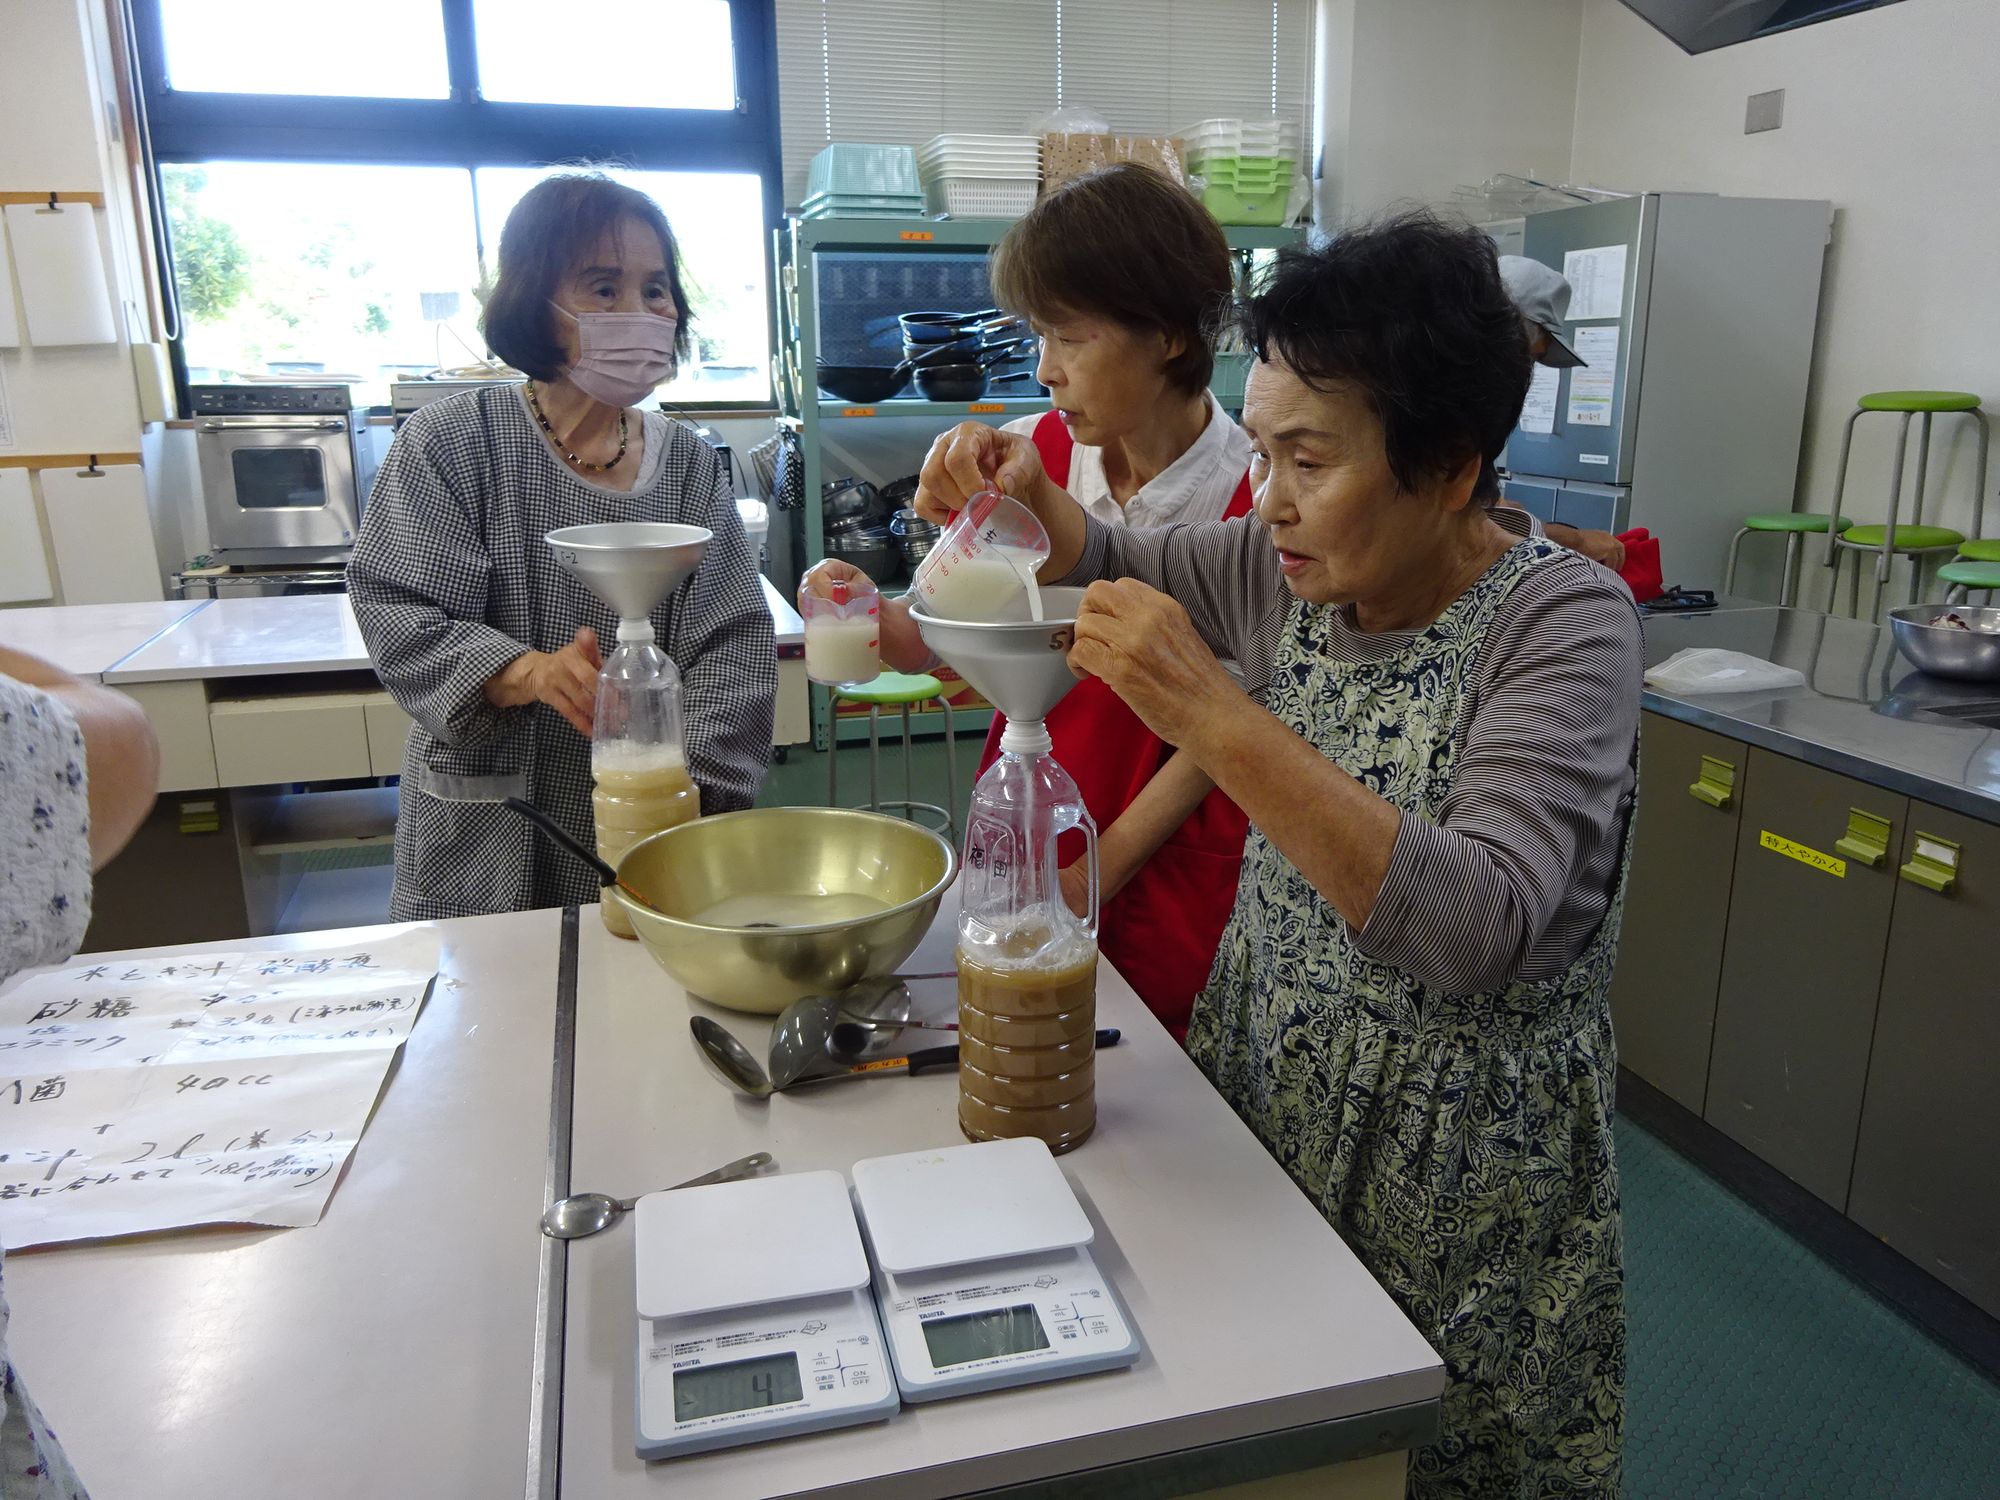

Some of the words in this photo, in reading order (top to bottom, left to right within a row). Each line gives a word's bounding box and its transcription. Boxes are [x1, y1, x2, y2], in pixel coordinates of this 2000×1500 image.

[951, 552, 960, 565] 70
[941, 566, 950, 577] 50
[926, 583, 936, 595] 20
[1764, 834, 1843, 874] 特大やかん
[257, 953, 381, 975] 発酵液
[26, 996, 140, 1025] 砂糖
[1093, 1327, 1110, 1336] OFF
[852, 1378, 870, 1386] OFF
[752, 1372, 774, 1407] 4
